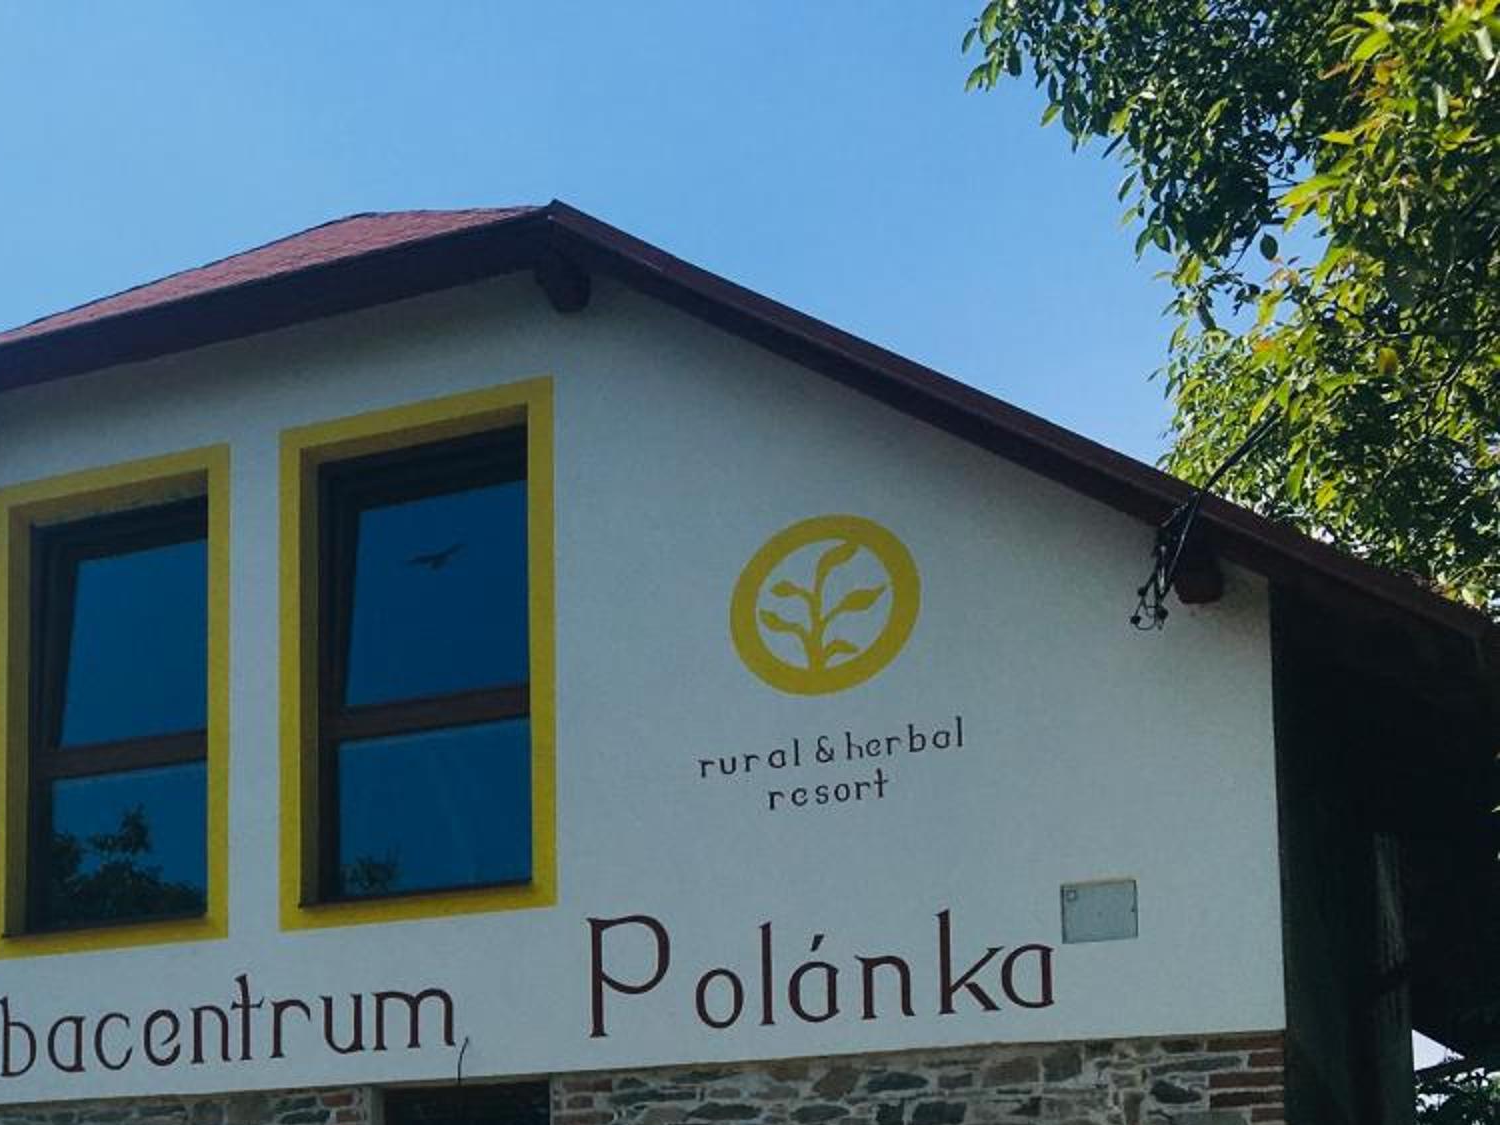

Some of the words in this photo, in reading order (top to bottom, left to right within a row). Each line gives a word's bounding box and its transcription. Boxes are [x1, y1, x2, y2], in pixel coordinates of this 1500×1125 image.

[698, 738, 801, 778] rural
[845, 716, 964, 761] herbal
[768, 767, 890, 811] resort
[586, 907, 1055, 1038] Polánka
